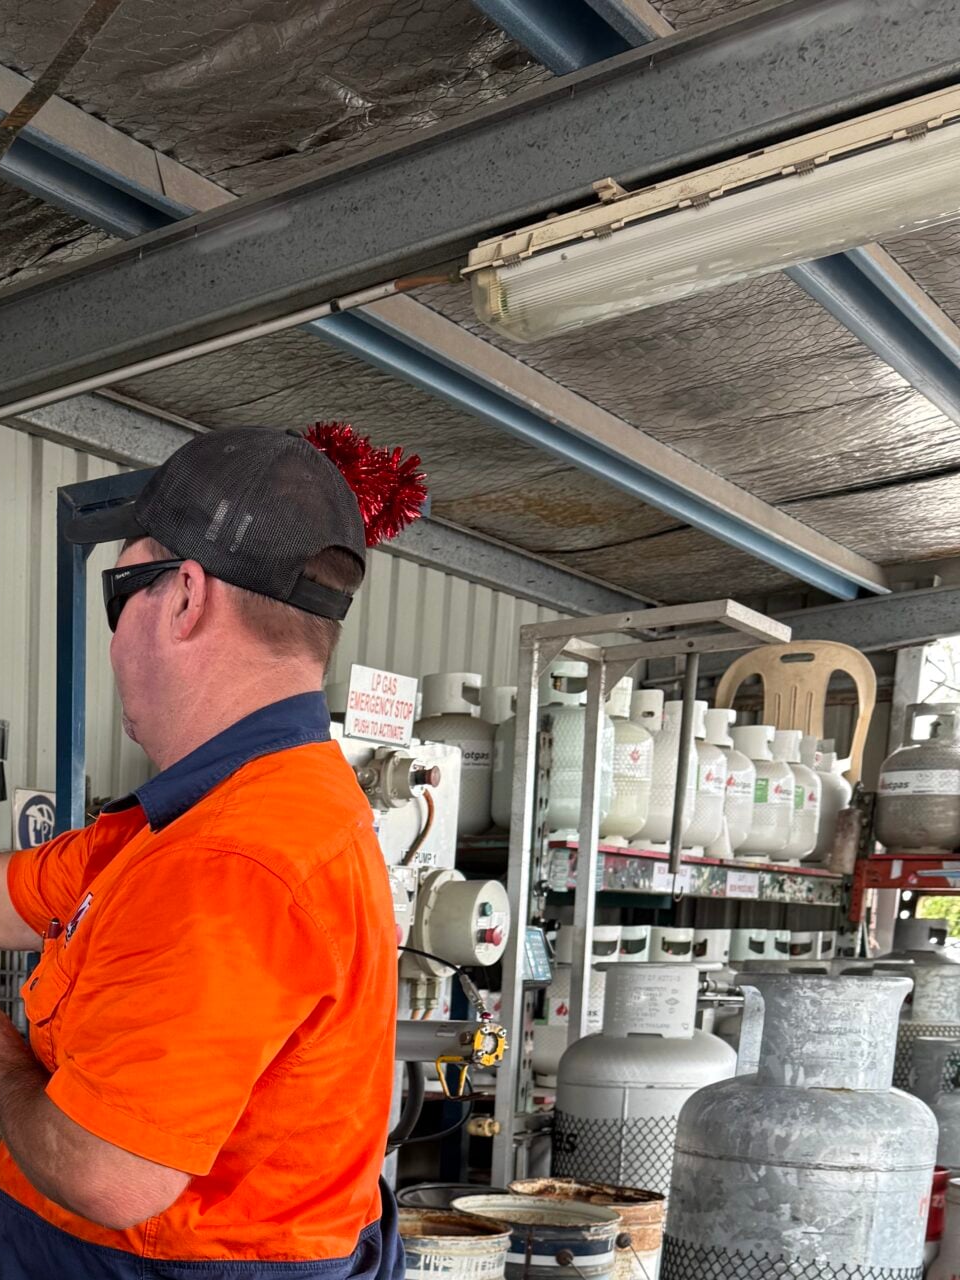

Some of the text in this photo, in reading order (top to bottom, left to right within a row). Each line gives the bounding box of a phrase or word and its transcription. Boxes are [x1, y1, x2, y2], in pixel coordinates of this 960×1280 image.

[371, 672, 397, 696] LP GAS
[350, 690, 413, 720] EMERGENCY STOP
[354, 718, 404, 740] PUSH TO ACTIVATE
[414, 851, 432, 864] PUMP
